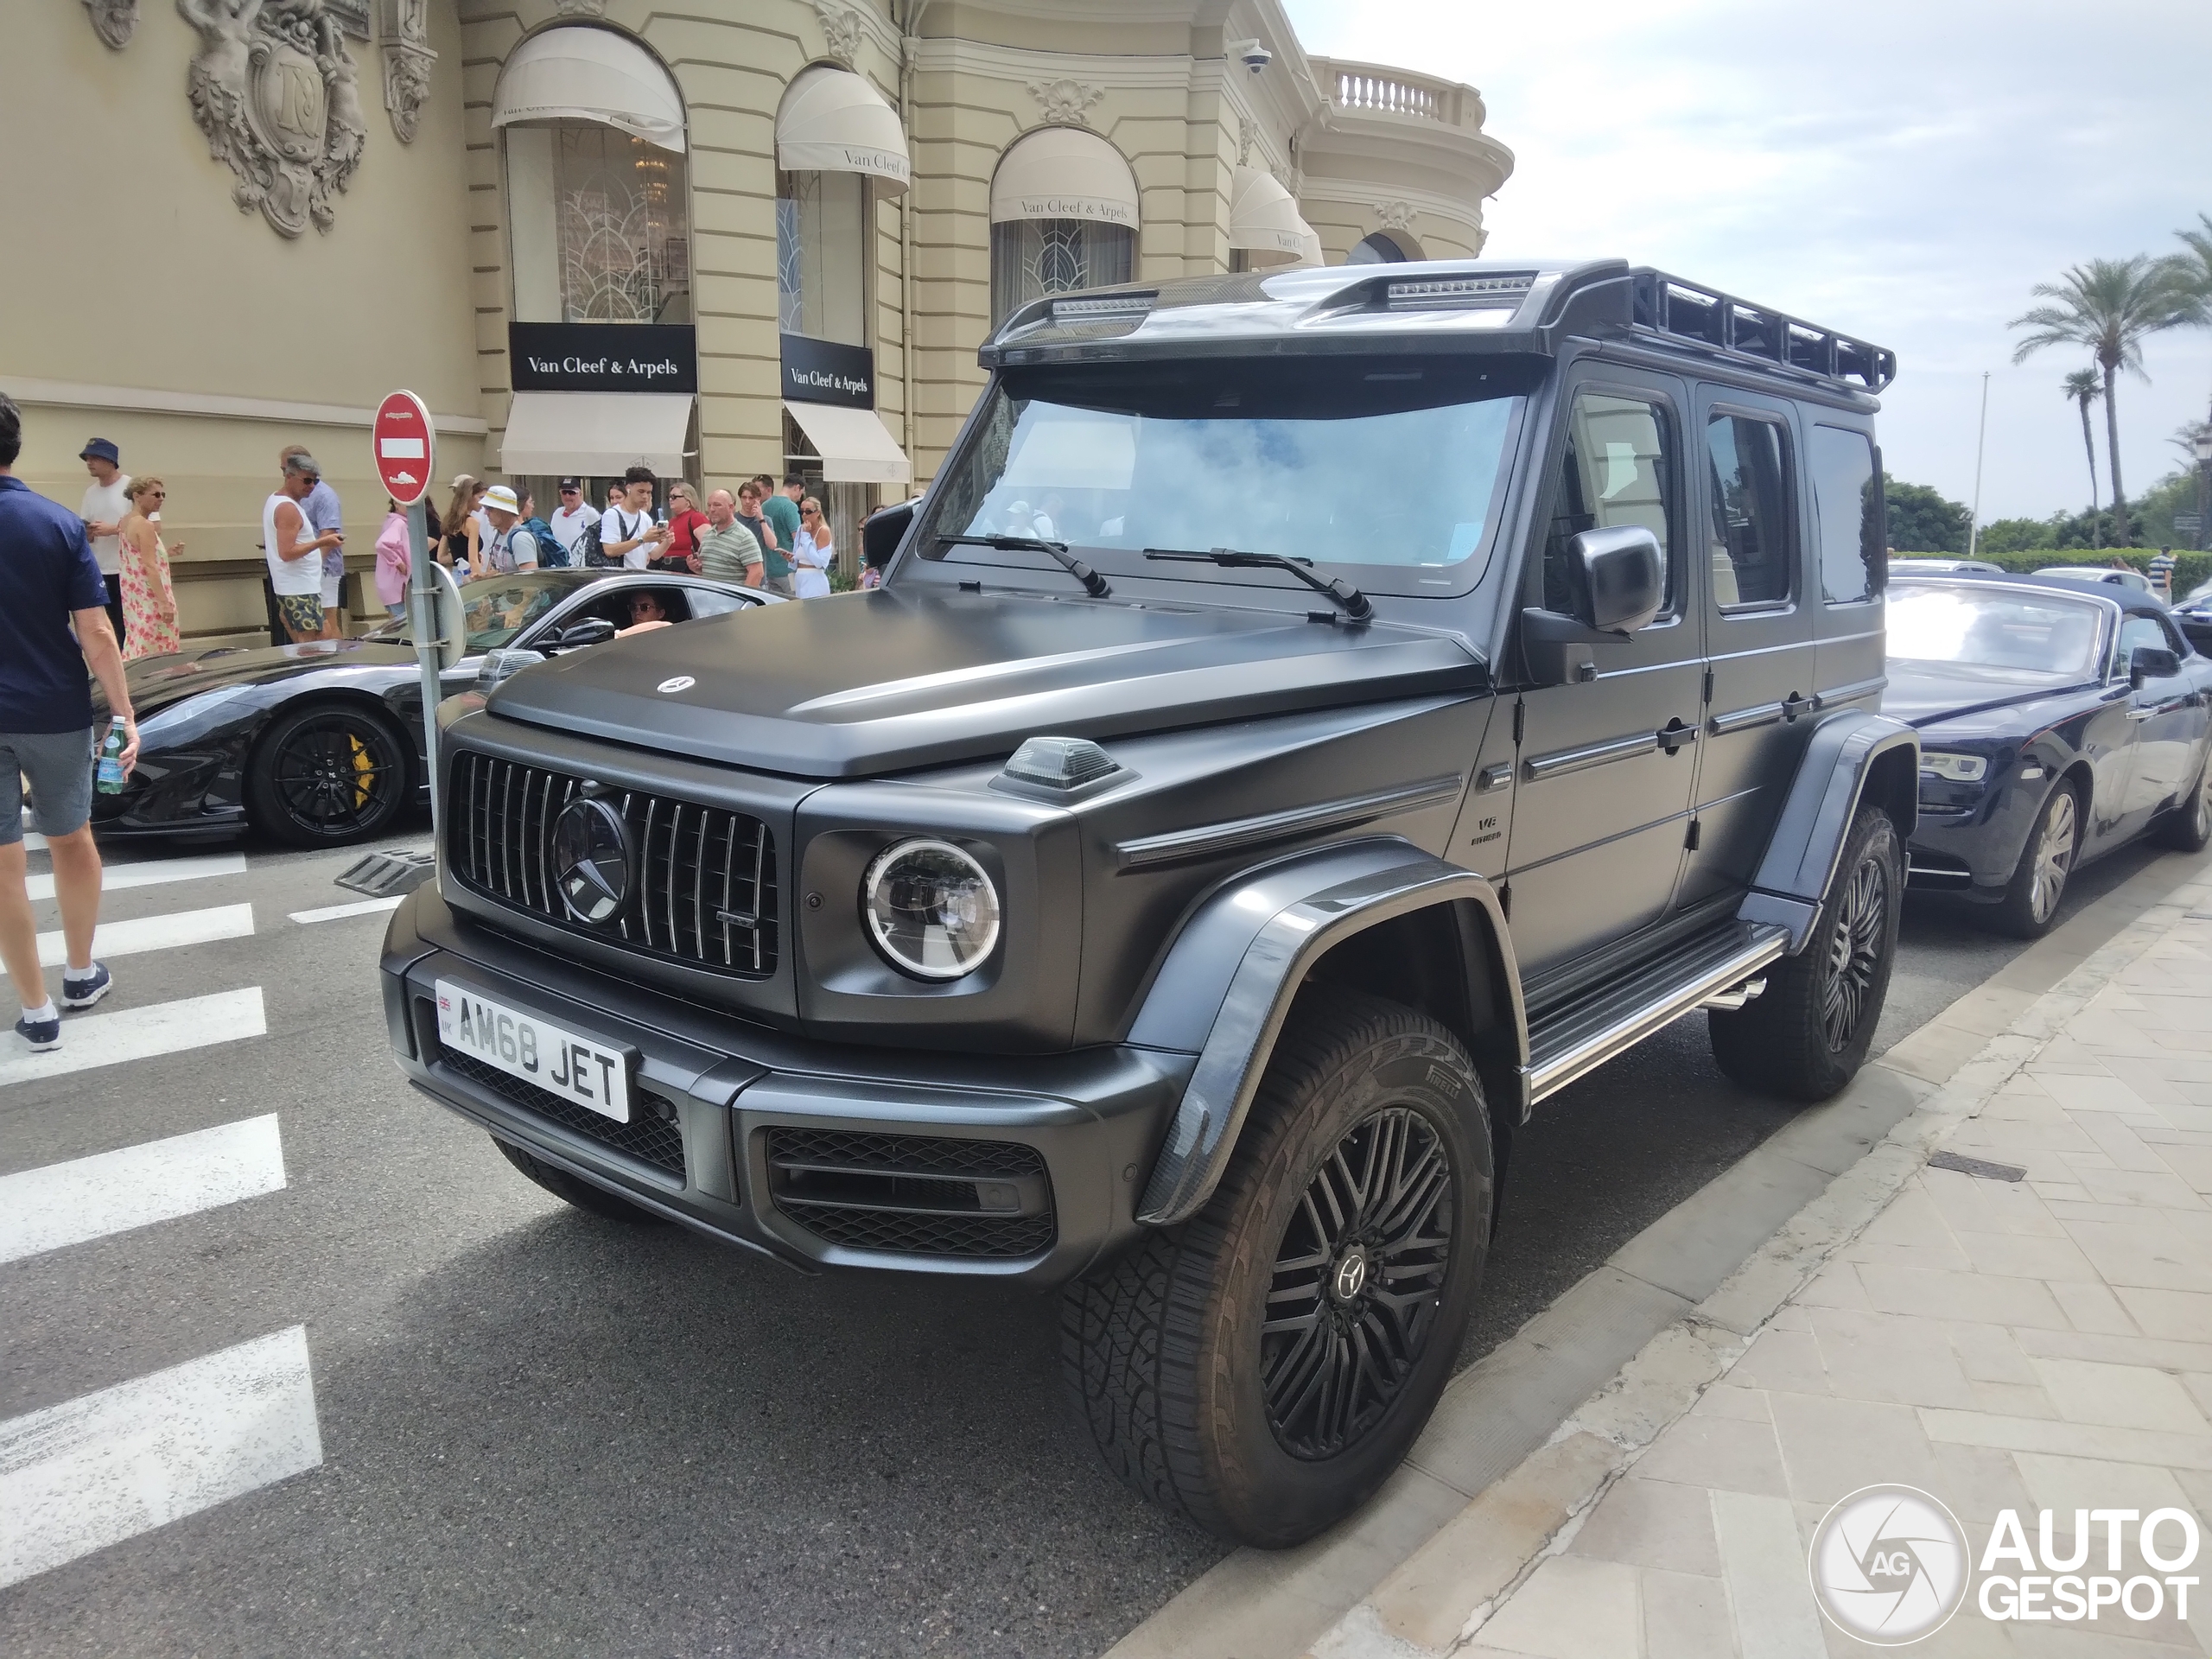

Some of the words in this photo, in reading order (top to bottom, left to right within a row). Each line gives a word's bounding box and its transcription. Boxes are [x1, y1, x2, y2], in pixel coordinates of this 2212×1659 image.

[844, 150, 870, 167] Van
[874, 154, 900, 173] Cleef
[1021, 200, 1043, 213] Van
[1047, 200, 1083, 213] Cleef
[1085, 205, 1095, 214] &
[1099, 203, 1128, 220] Arpels
[1277, 234, 1292, 248] Van
[528, 357, 559, 372] Van
[563, 357, 607, 373] Cleef
[611, 361, 622, 373] &
[626, 359, 678, 378] Arpels
[791, 367, 809, 385] Van
[810, 370, 833, 388] Cleef
[835, 377, 842, 389] &
[842, 375, 868, 395] Arpels
[442, 1020, 453, 1035] UK
[460, 997, 539, 1074] AM68
[550, 1039, 615, 1106] JET
[1425, 1064, 1462, 1100] PIRELLI
